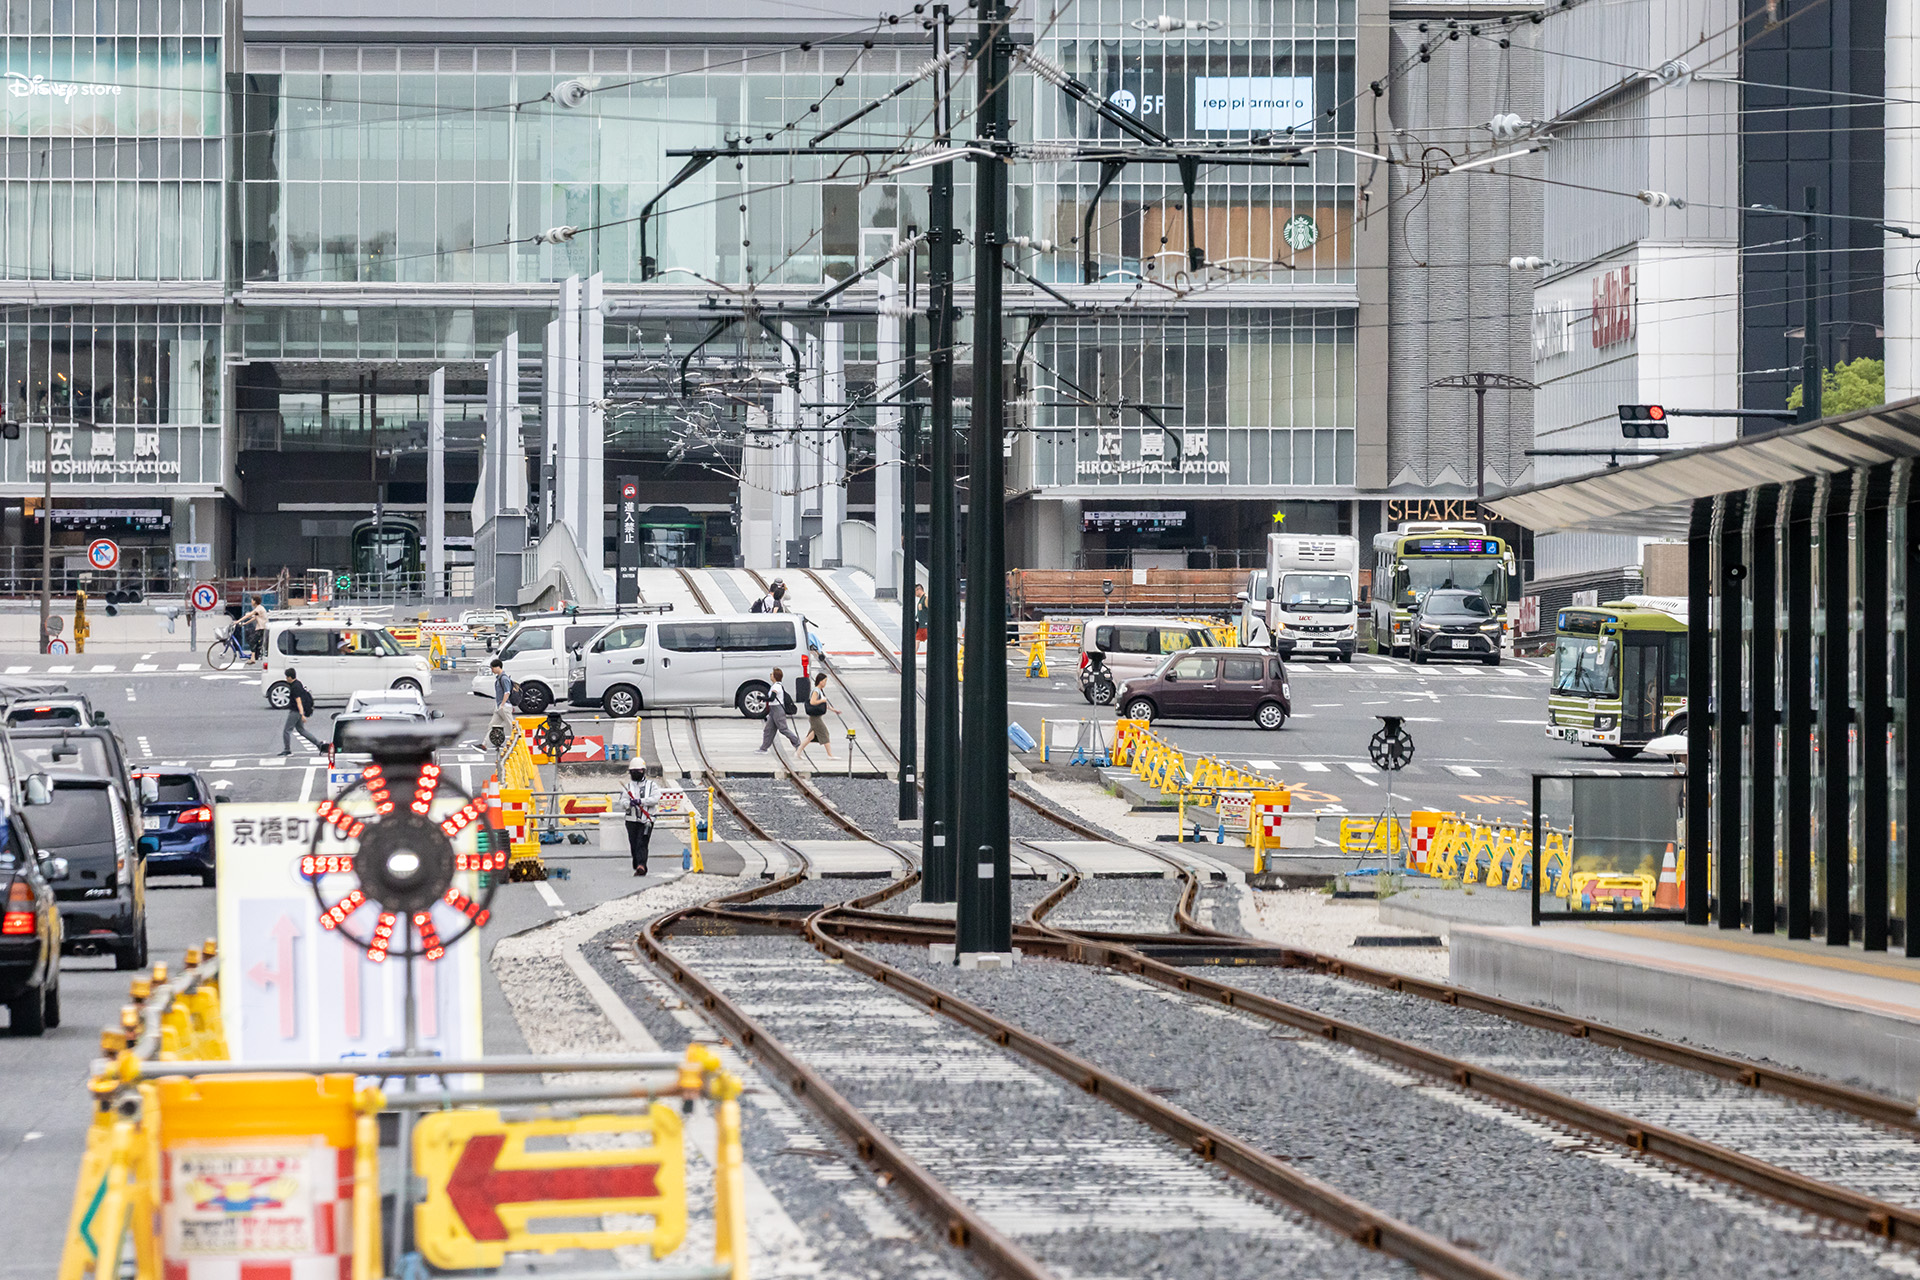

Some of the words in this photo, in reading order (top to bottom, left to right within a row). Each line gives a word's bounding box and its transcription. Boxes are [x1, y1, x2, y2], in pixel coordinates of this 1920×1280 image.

[81, 84, 122, 96] store
[1141, 95, 1165, 114] 5F
[50, 431, 160, 457] 広島駅
[1096, 432, 1209, 457] 広島駅
[119, 459, 181, 474] STATION
[1075, 460, 1161, 474] HIROSHIMA
[1387, 499, 1477, 521] SHAKE
[624, 501, 635, 544] 進入禁止
